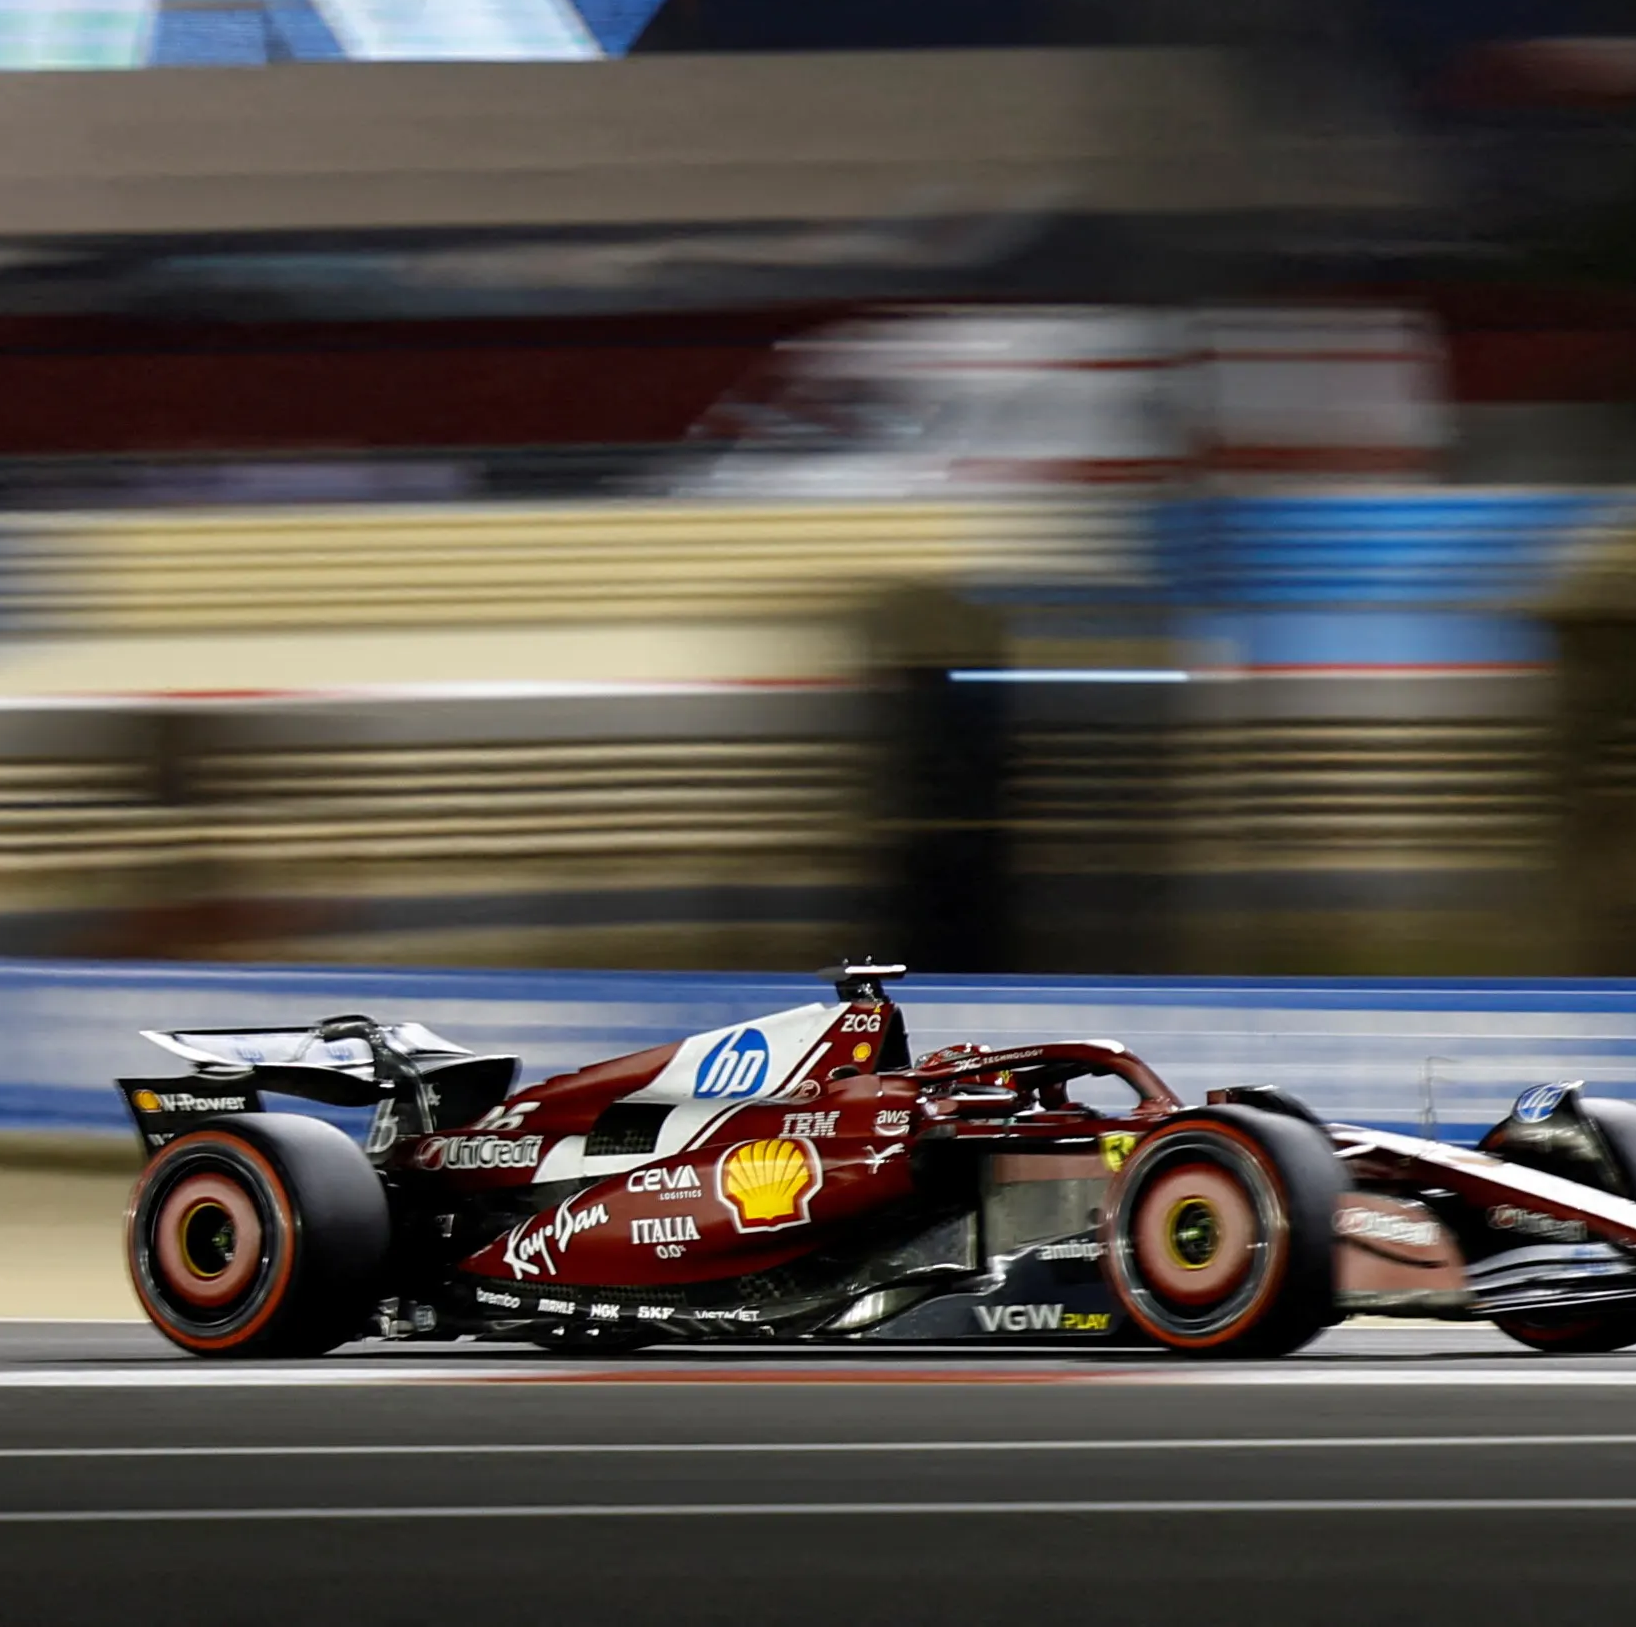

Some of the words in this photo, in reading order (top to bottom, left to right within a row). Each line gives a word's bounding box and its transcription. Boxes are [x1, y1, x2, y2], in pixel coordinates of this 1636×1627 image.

[840, 1014, 882, 1032] ZCG
[696, 1028, 768, 1098] hp
[983, 1048, 1044, 1065] TECHNOLOGY
[778, 1111, 840, 1138] IBM
[876, 1110, 911, 1125] aws
[445, 1135, 544, 1168] UniCredit
[659, 1189, 702, 1200] LOGISTICS
[631, 1215, 701, 1244] ITALIA
[476, 1287, 521, 1309] brembo
[537, 1298, 576, 1315] MAHLE
[590, 1304, 621, 1319] NGK
[637, 1306, 675, 1319] SKF
[973, 1304, 1064, 1332] VGW
[1062, 1313, 1111, 1330] PLAY
